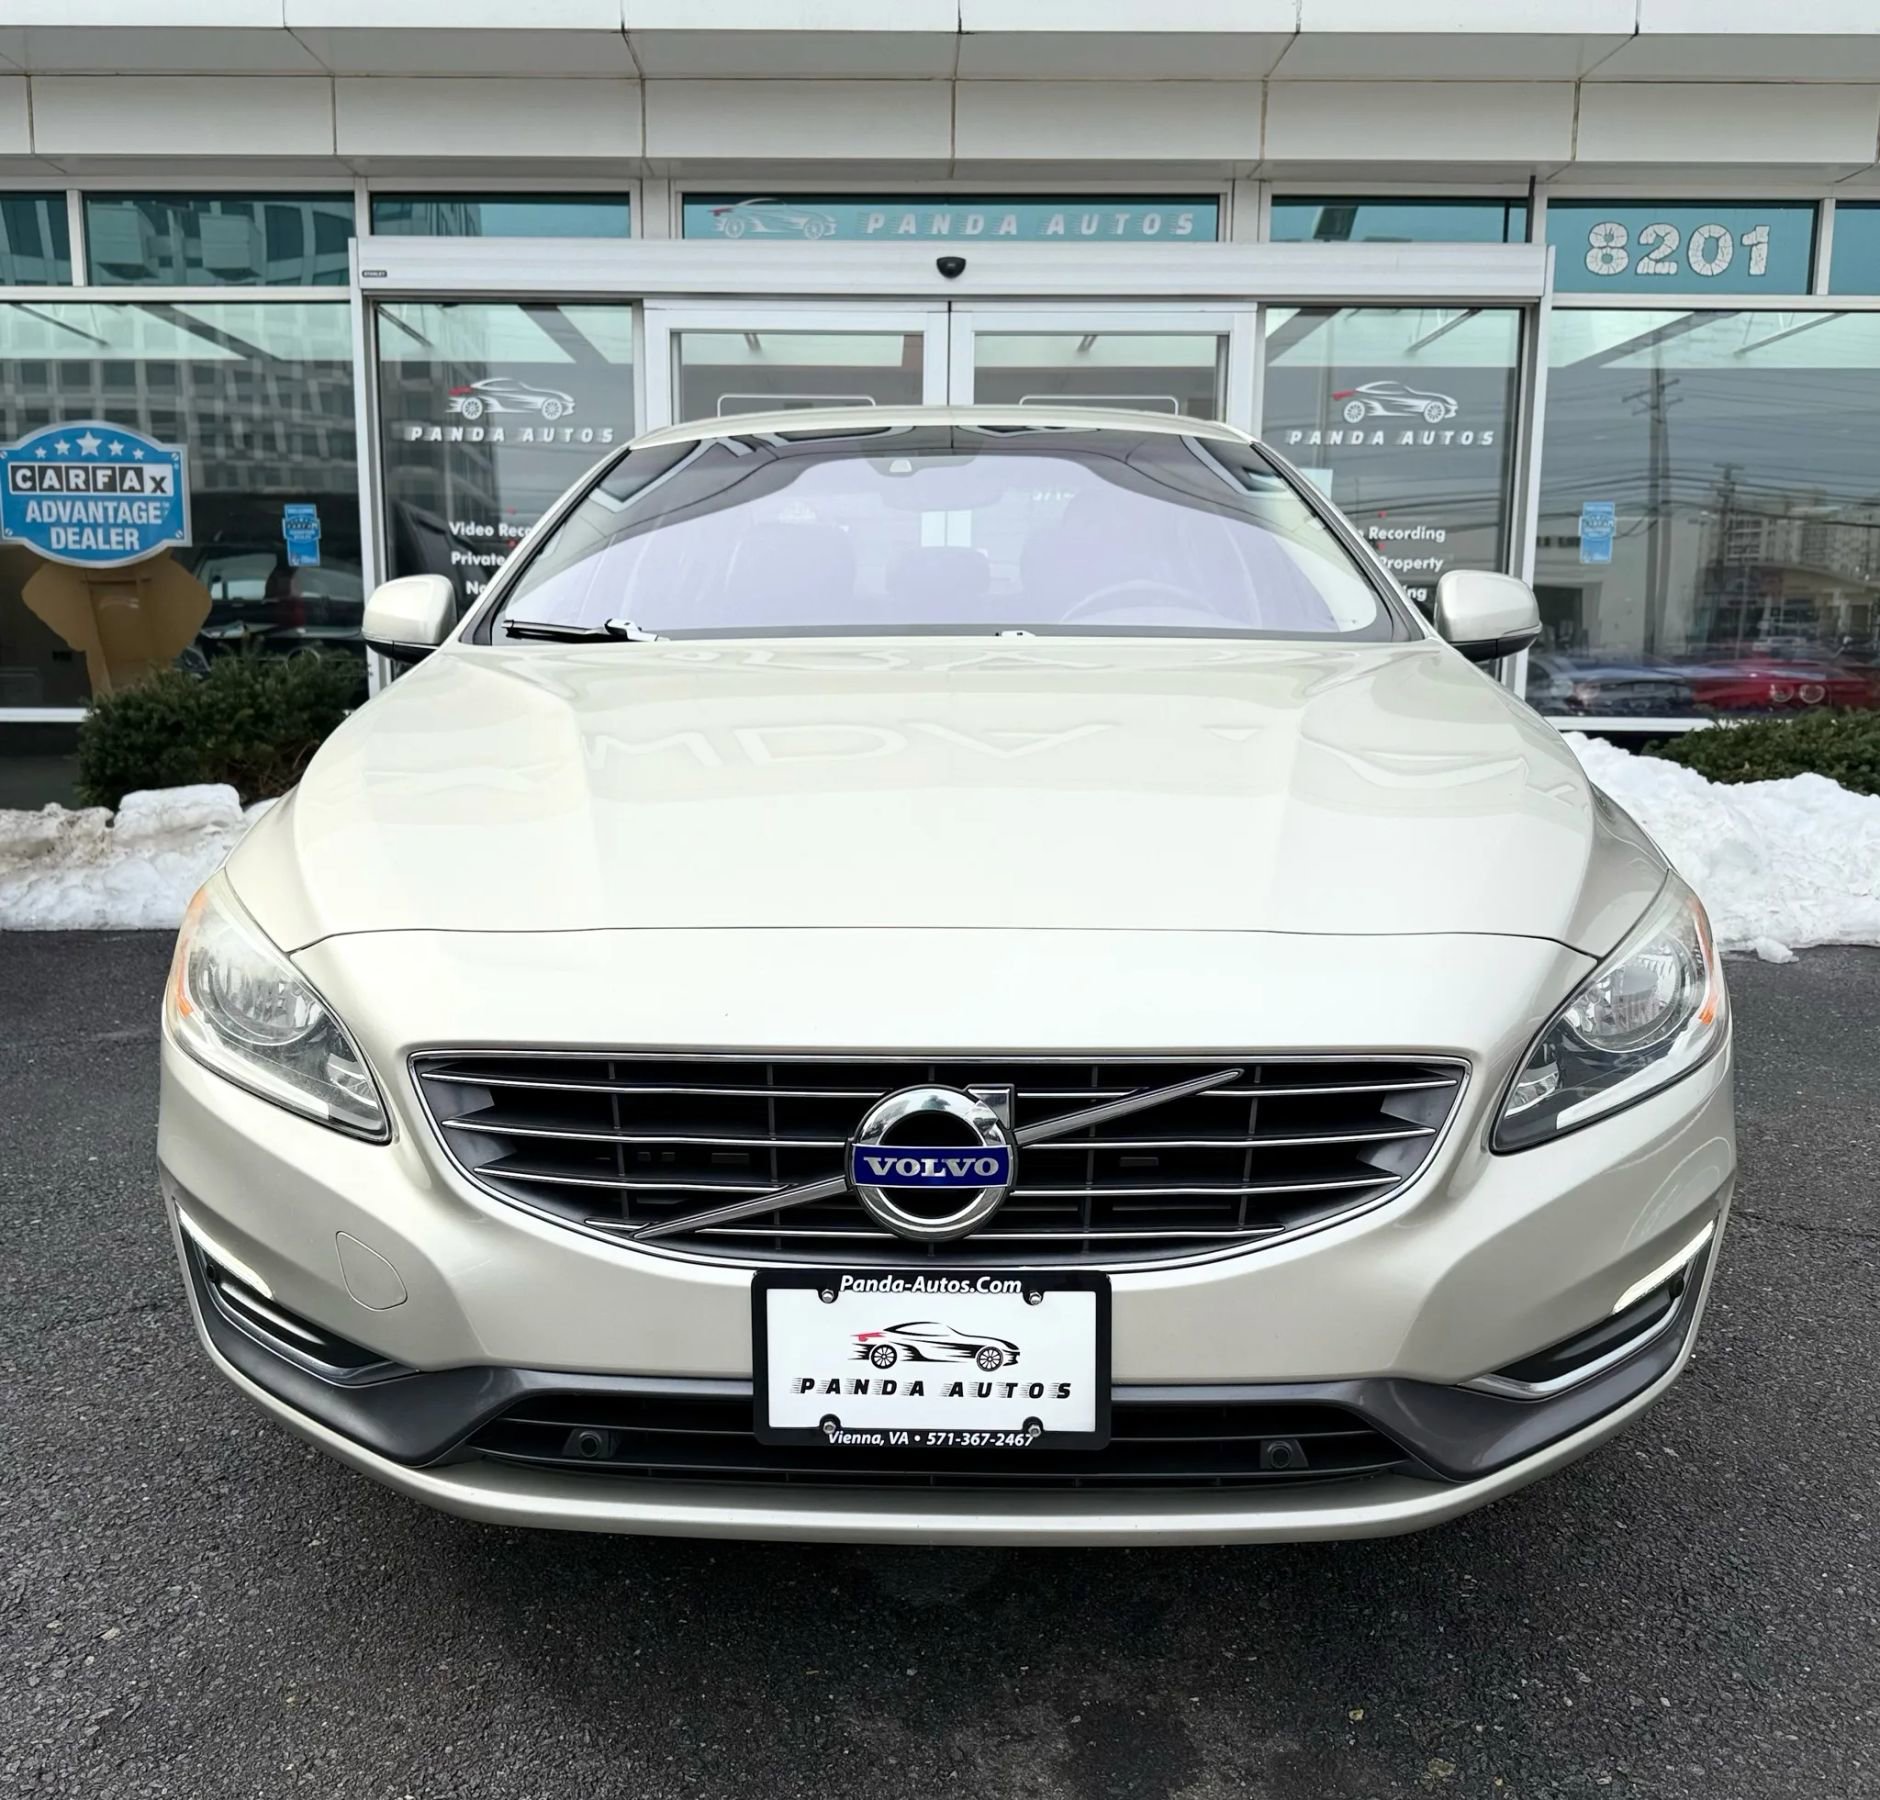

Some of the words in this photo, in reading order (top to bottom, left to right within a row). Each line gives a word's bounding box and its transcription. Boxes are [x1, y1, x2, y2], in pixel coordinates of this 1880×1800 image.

[864, 212, 1018, 236] PANDA
[1045, 212, 1195, 236] AUTOS
[1584, 221, 1772, 276] 8201
[409, 425, 505, 443] PANDA
[522, 427, 614, 443] AUTOS
[1289, 430, 1384, 445] PANDA
[1401, 430, 1495, 446] AUTOS
[13, 467, 168, 494] CARFAX
[25, 500, 162, 525] ADVANTAGE
[50, 526, 141, 551] DEALER
[450, 521, 494, 537] Video
[1368, 525, 1446, 543] Recording
[451, 551, 506, 567] Private
[863, 1156, 1000, 1177] VOLVO
[839, 1275, 1023, 1294] Panda-Autos.Com
[798, 1377, 926, 1397] PANDA
[947, 1380, 1072, 1400] AUTOS
[828, 1431, 885, 1447] Vienna,
[888, 1431, 910, 1445] VA
[925, 1433, 1034, 1447] 571-367-2467
